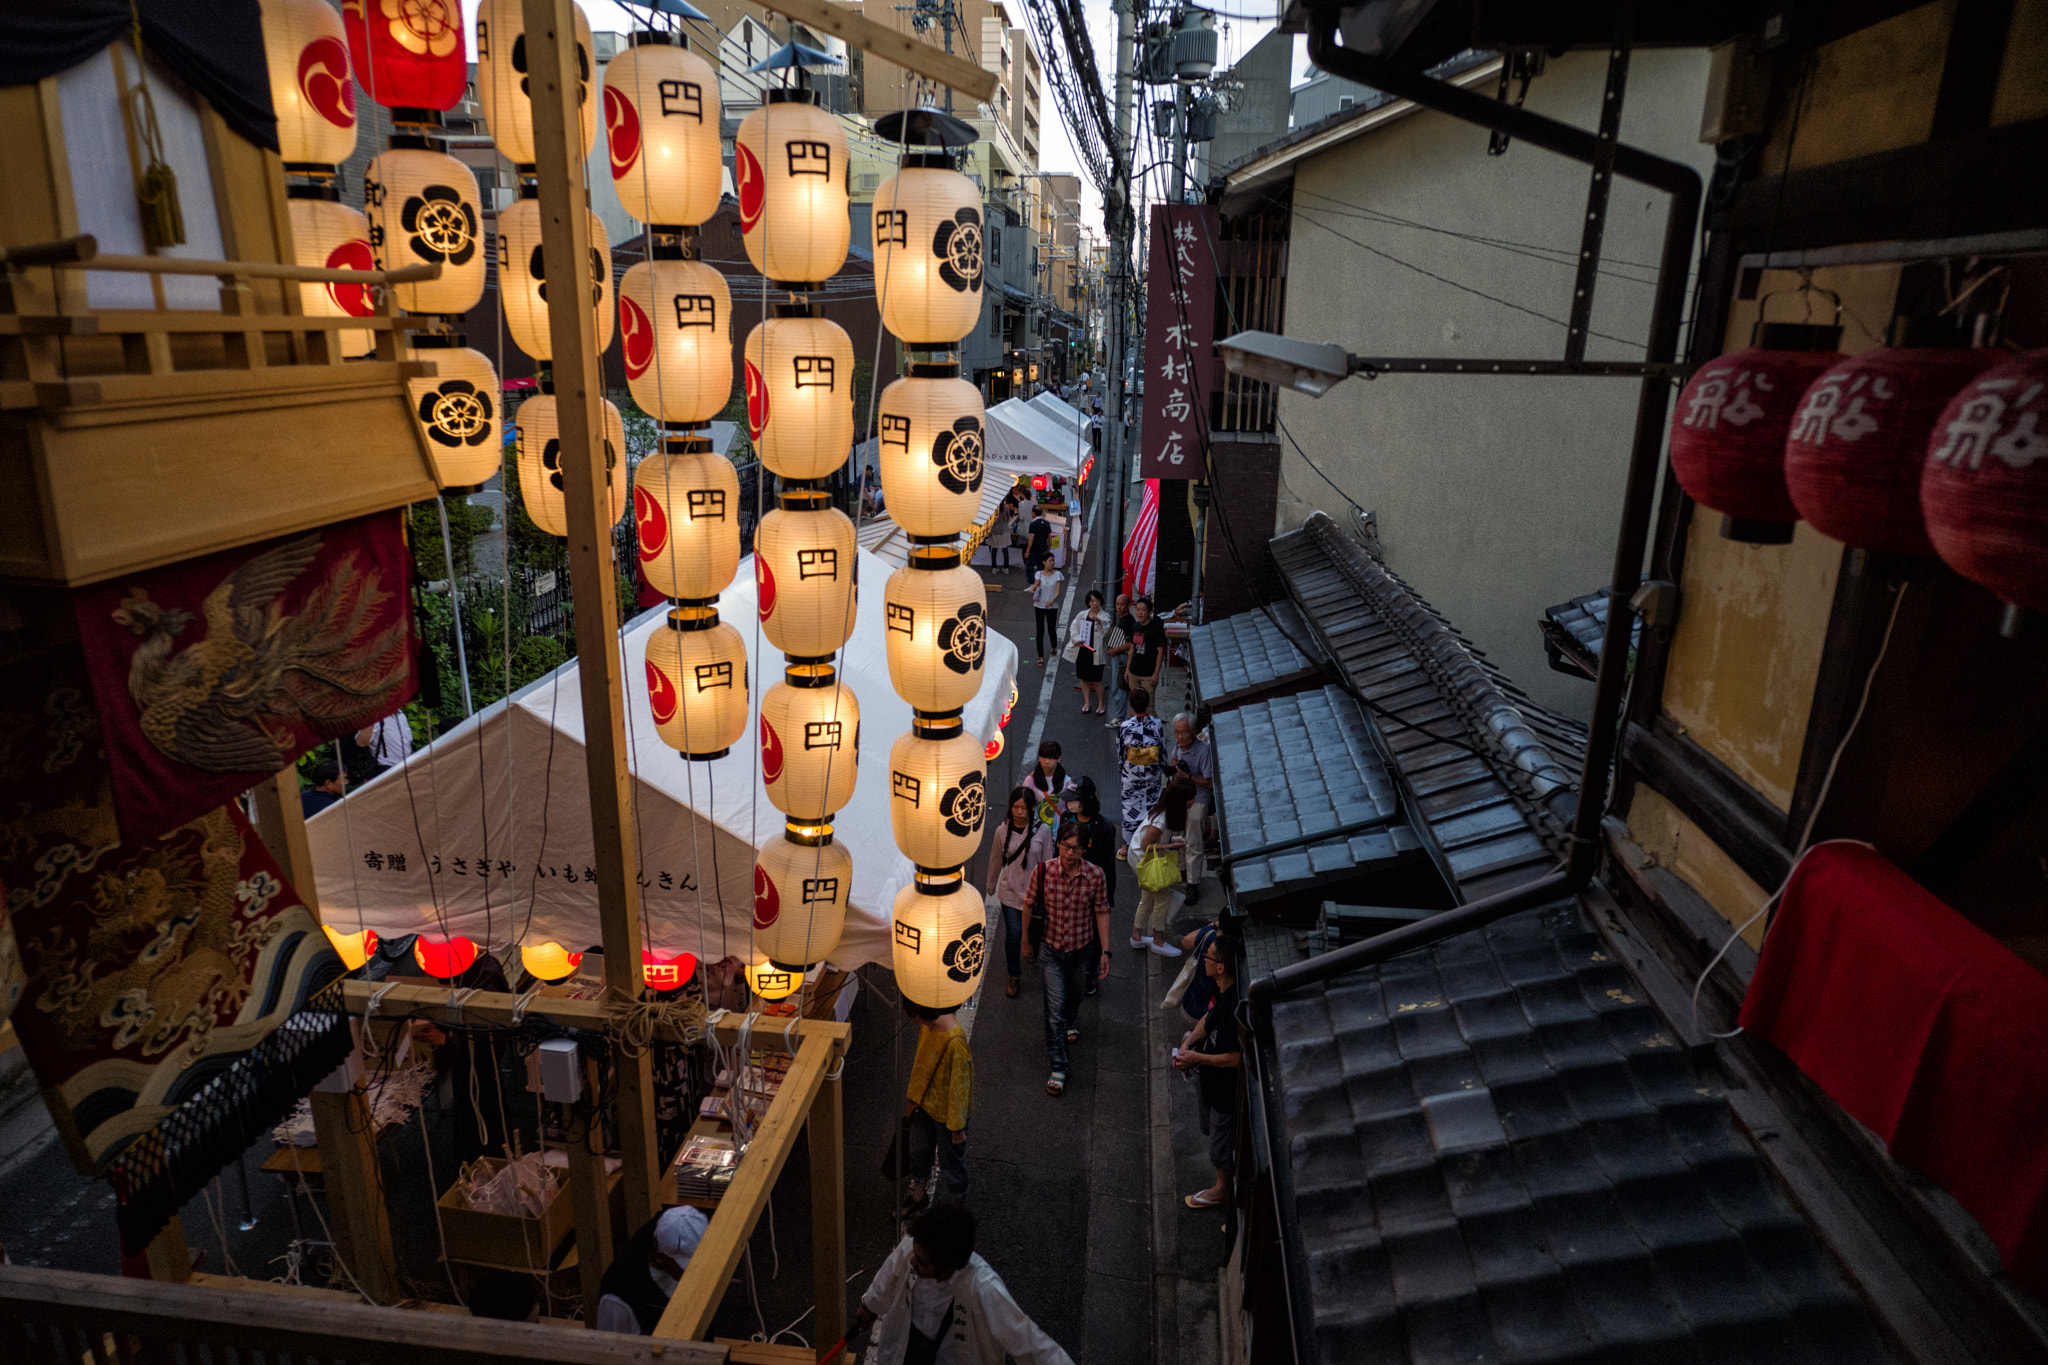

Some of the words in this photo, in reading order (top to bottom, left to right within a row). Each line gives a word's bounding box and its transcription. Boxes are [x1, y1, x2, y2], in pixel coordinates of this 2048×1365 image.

[658, 79, 703, 125] 四
[786, 140, 830, 183] 四
[876, 209, 908, 249] 四
[673, 294, 716, 333] 四
[793, 355, 834, 393] 四
[881, 413, 911, 454] 四
[687, 489, 726, 523] 四
[797, 548, 837, 582] 四
[887, 602, 915, 642] 四
[695, 661, 733, 693] 四
[804, 721, 842, 751] 四
[893, 770, 921, 810] 四
[364, 851, 407, 872] 寄贈
[430, 855, 516, 879] うさぎや
[802, 877, 838, 905] 四
[895, 919, 921, 955] 四
[758, 972, 791, 992] 四
